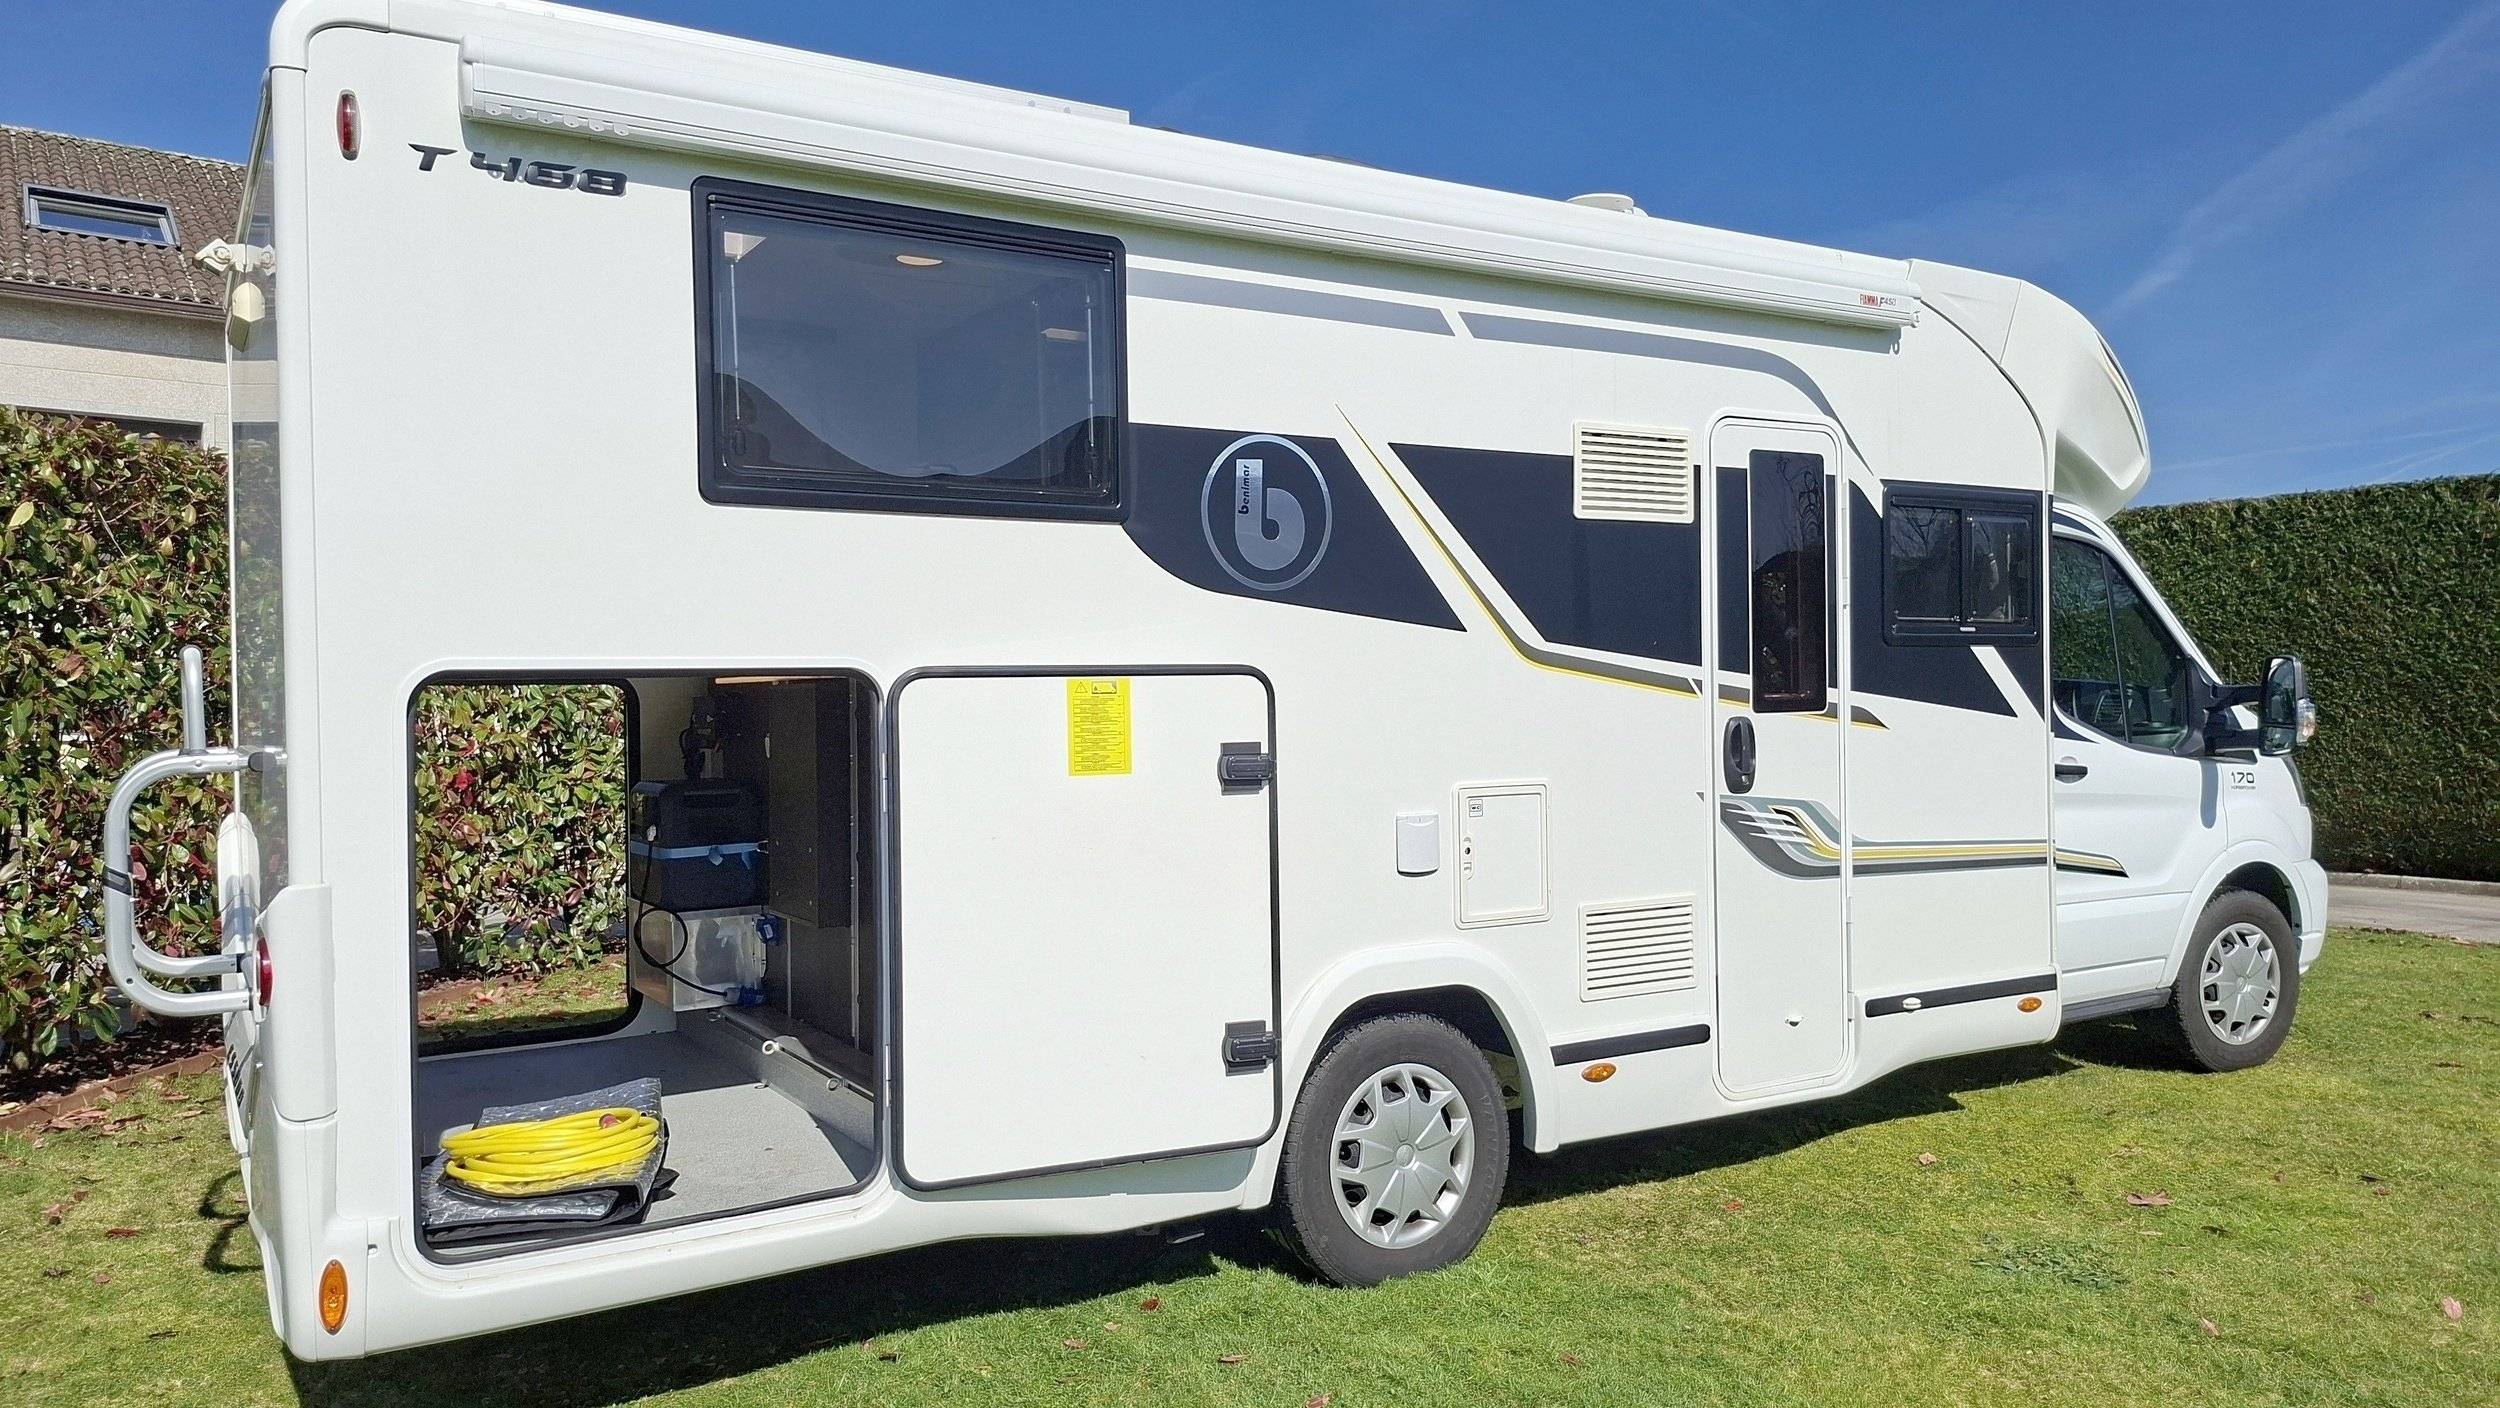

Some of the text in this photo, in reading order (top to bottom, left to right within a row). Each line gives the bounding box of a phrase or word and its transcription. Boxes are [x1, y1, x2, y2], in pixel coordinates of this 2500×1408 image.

[408, 143, 628, 197] T 468
[1238, 464, 1250, 515] benimar
[2231, 771, 2255, 784] 170
